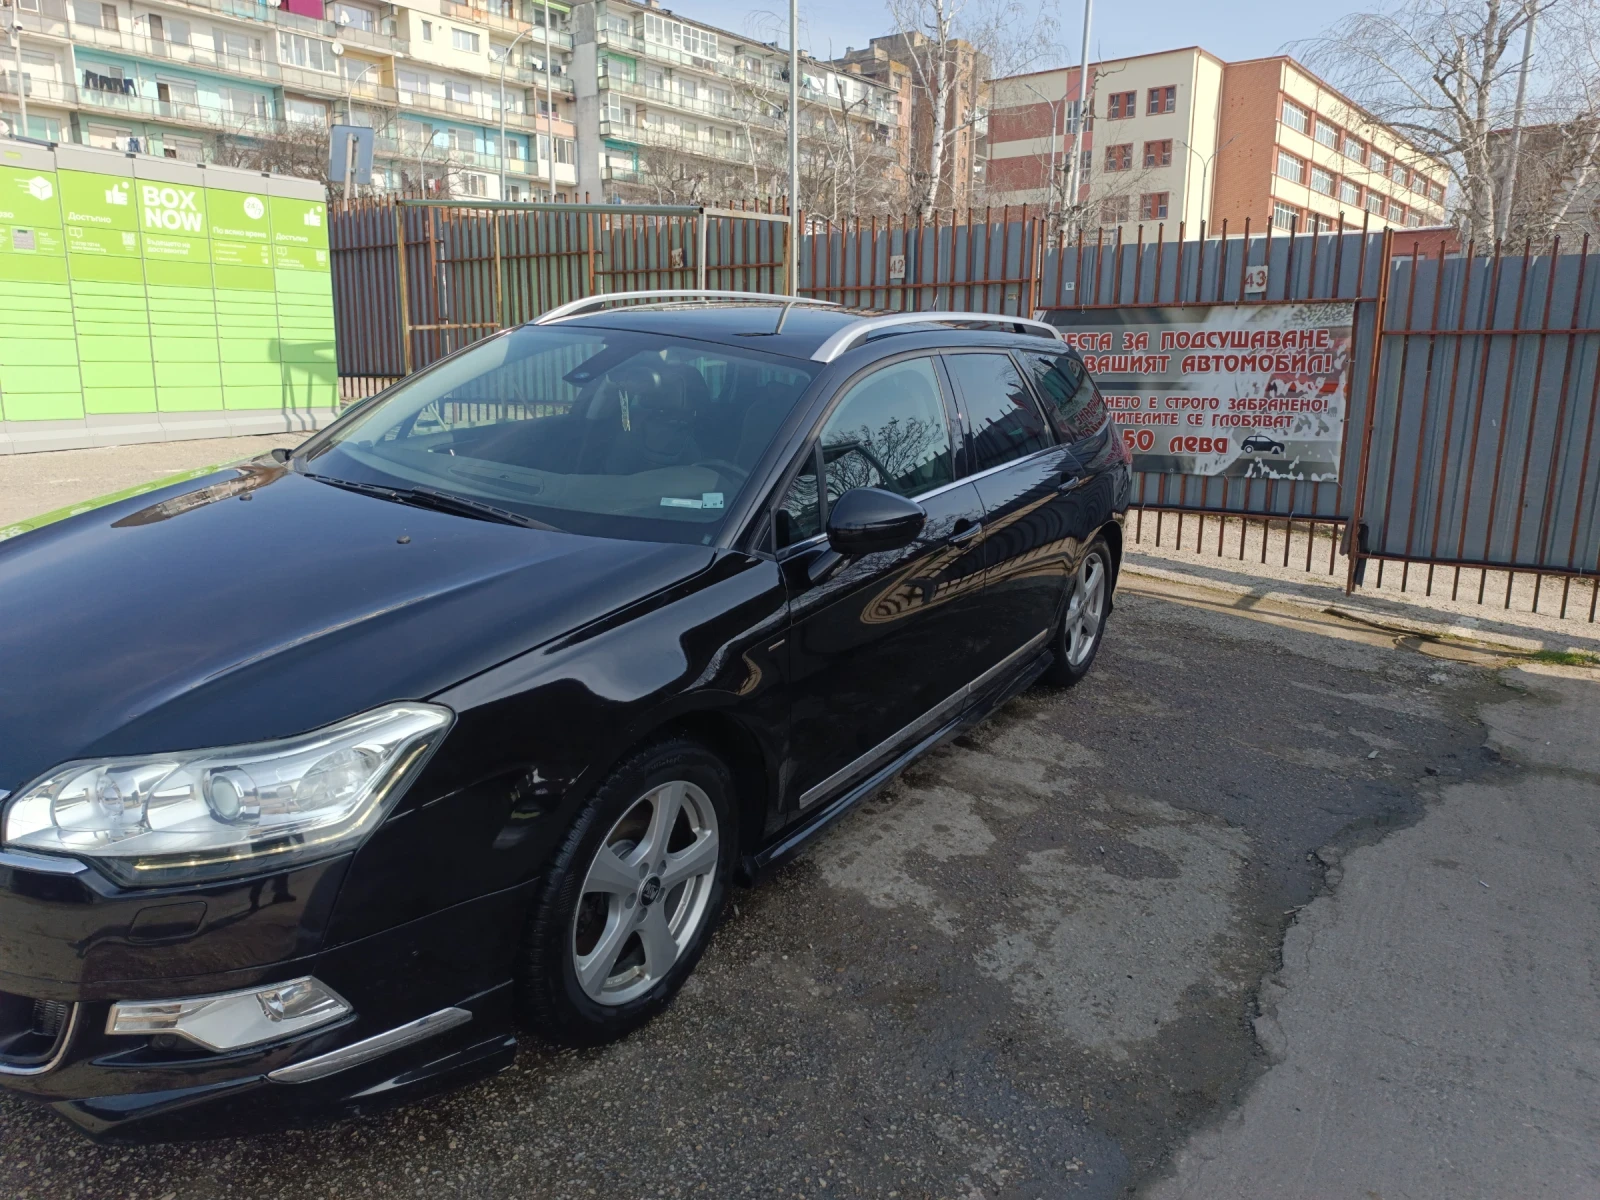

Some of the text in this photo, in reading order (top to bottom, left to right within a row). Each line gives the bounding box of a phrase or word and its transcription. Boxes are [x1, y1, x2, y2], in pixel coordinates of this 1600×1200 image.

[142, 185, 197, 211] BOX
[68, 211, 112, 224] Достъпно
[144, 207, 203, 232] NOW
[213, 226, 224, 235] По
[225, 228, 245, 237] всяко
[275, 232, 309, 243] Достъпно
[890, 259, 904, 274] 42
[1244, 270, 1267, 287] 43
[1122, 331, 1149, 351] ЗА
[1160, 329, 1330, 352] ПОДСУШАВАНЕ
[1083, 353, 1333, 375] ВАШИЯТ АВТОМОБИЛ!
[1102, 396, 1329, 412] НЕТО Е СТРОГО ЗАБРАНЕНО!
[1186, 413, 1204, 426] СЕ
[1211, 414, 1295, 430] ГЛОБЯВАТ
[1169, 436, 1229, 454] лева
